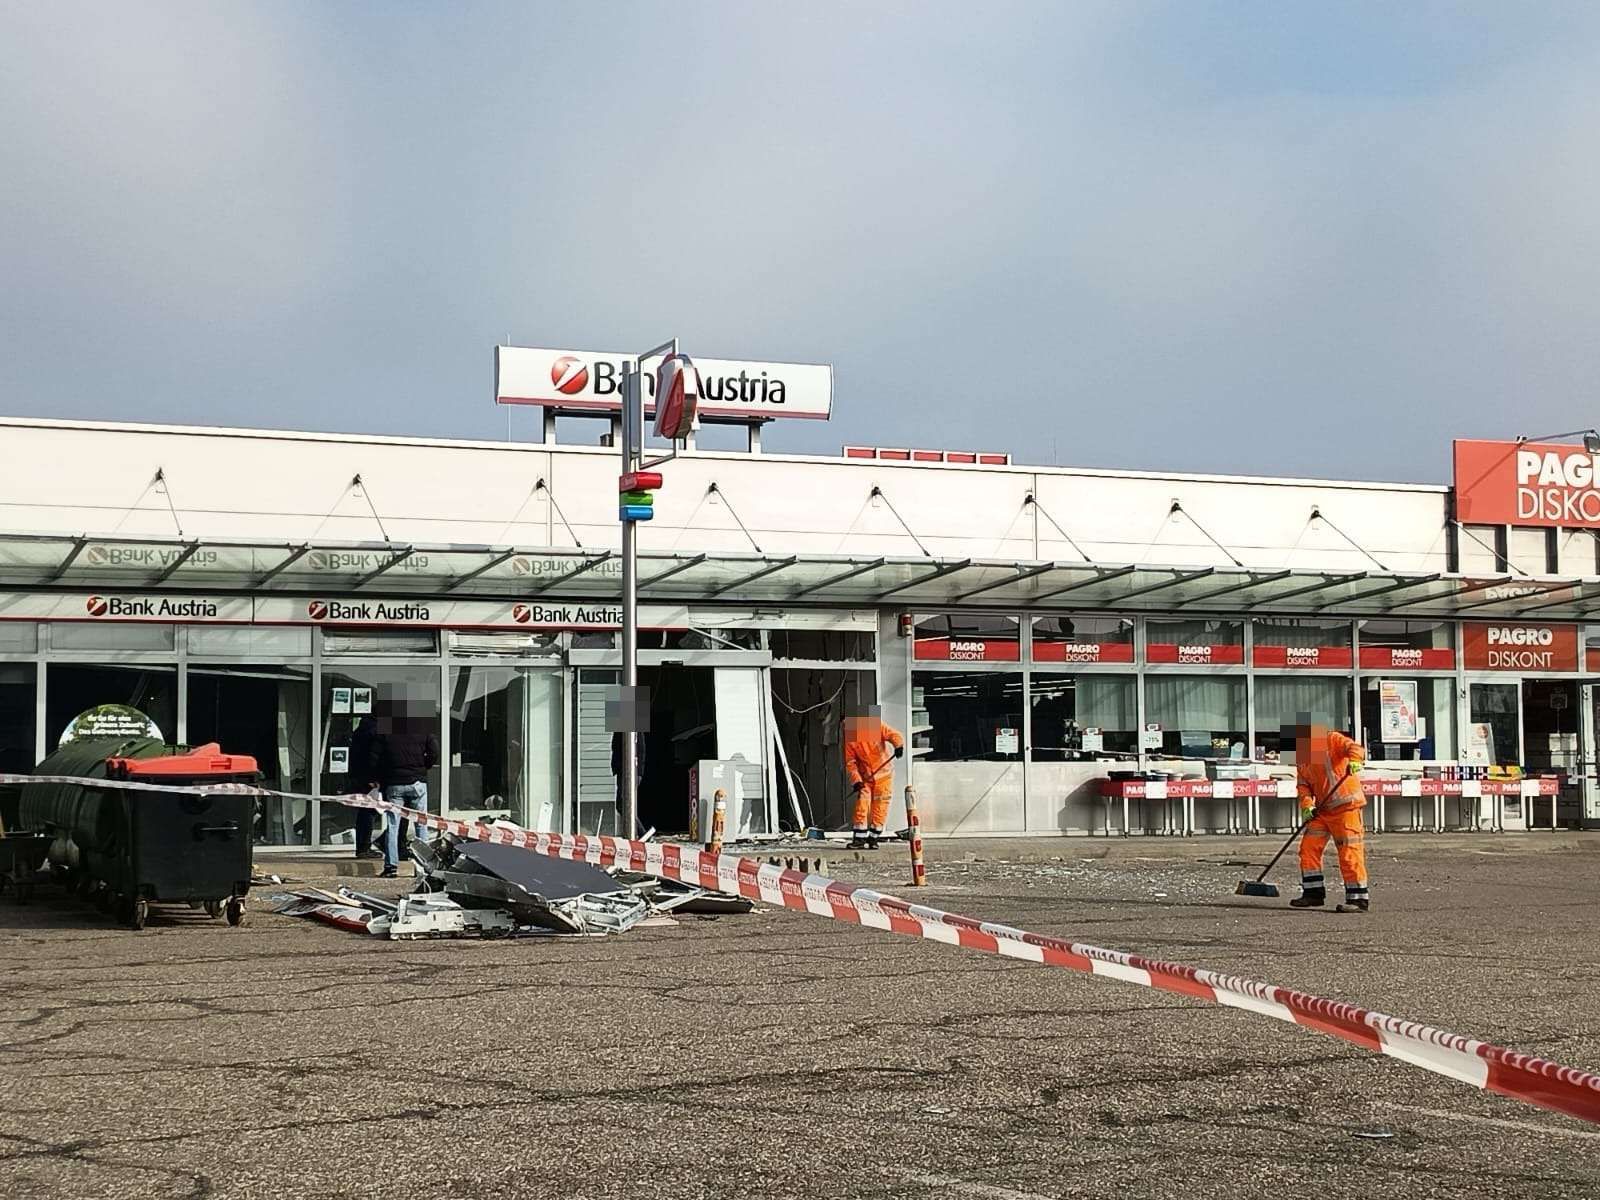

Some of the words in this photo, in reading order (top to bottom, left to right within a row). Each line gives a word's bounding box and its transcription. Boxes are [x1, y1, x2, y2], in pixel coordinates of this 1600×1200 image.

[1517, 450, 1600, 488] PAG
[109, 598, 154, 616] Bank
[158, 599, 217, 617] Austria
[329, 602, 372, 619] Bank
[374, 603, 430, 620] Austria
[532, 606, 572, 623] Bank
[1487, 627, 1553, 646] PAGRO
[949, 642, 985, 651] PAGRO
[1065, 644, 1100, 653] PAGRO
[1178, 645, 1211, 654] PAGRO
[949, 651, 985, 660] DISKONT
[1286, 647, 1319, 656] PAGRO
[1391, 649, 1423, 657] PAGRO
[1065, 653, 1100, 662] DISKONT
[1178, 654, 1211, 664] DISKONT
[1286, 656, 1319, 665] DISKONT
[1391, 657, 1423, 666] DISKONT
[1487, 651, 1554, 668] DISKONT
[1126, 785, 1146, 794] PAG
[1191, 785, 1213, 794] PAG
[1256, 784, 1278, 793] PAG
[1382, 783, 1402, 792] PAG
[1442, 783, 1462, 792] PAG
[1502, 783, 1521, 792] PAG
